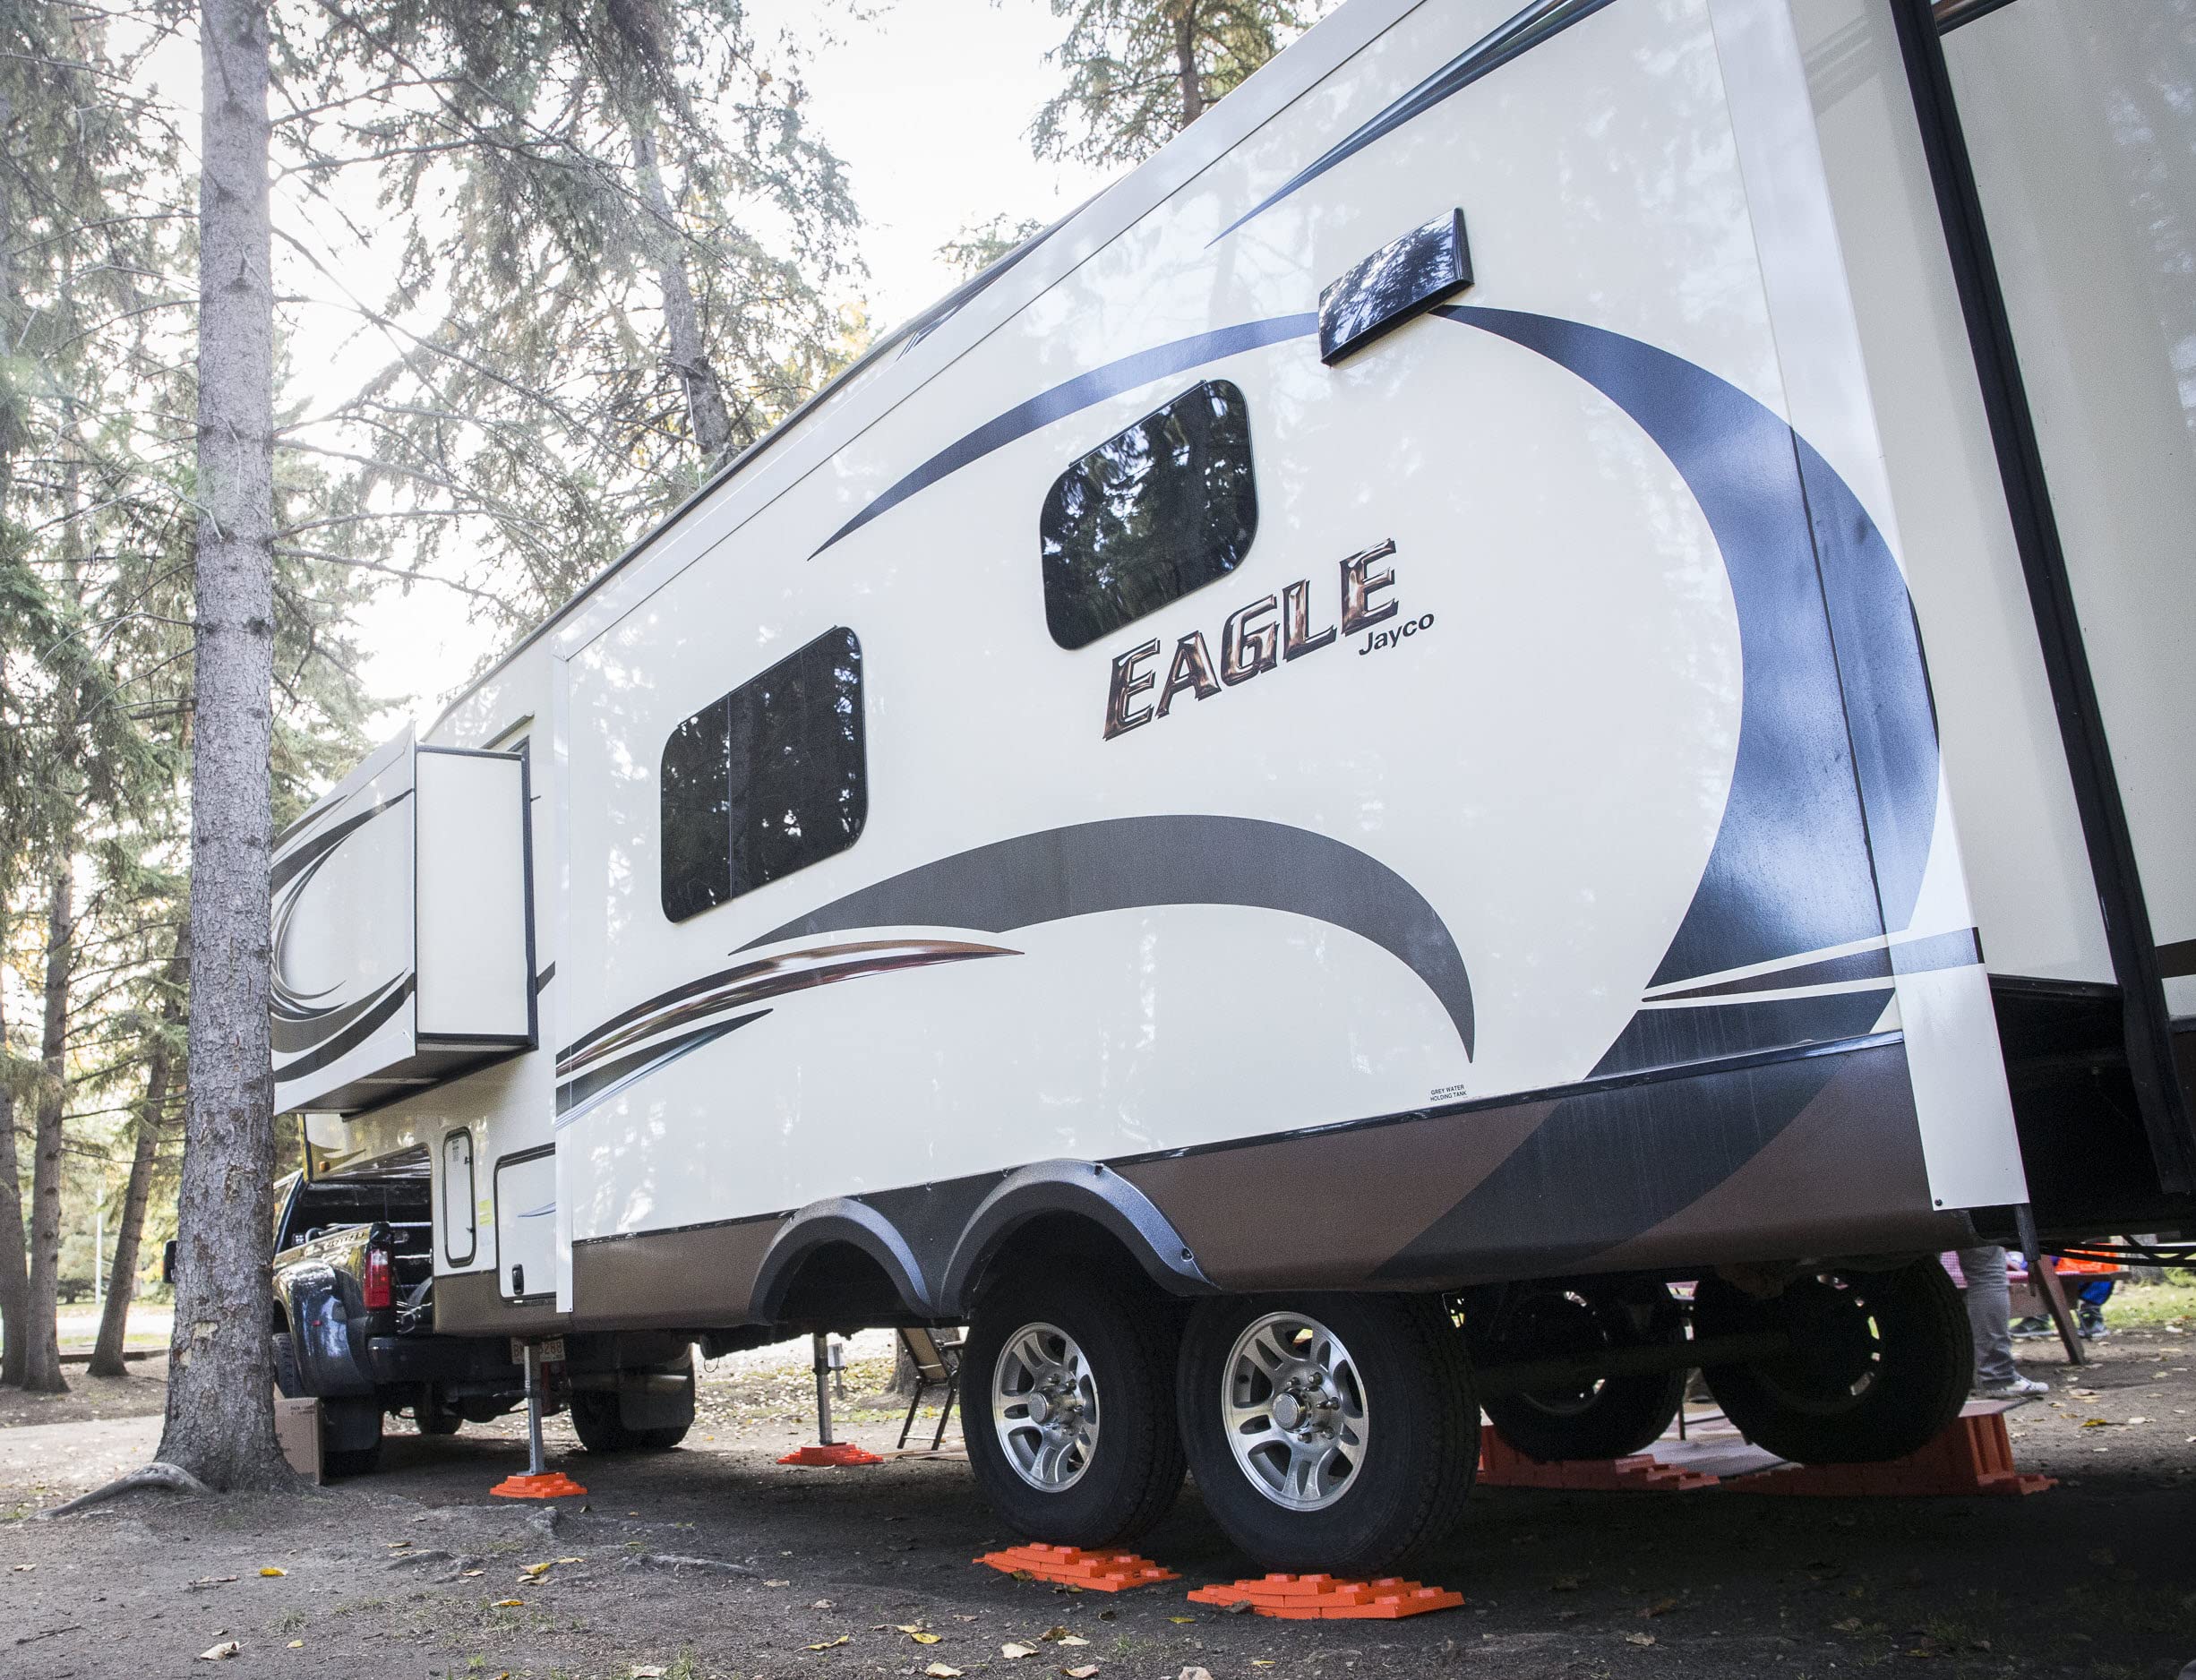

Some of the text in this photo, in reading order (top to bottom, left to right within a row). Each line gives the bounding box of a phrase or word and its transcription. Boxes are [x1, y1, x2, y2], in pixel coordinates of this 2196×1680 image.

[1102, 537, 1399, 741] EAGLE
[1359, 613, 1435, 656] Jayco
[1430, 1093, 1452, 1101] HOLDING
[1445, 1084, 1464, 1093] WATER
